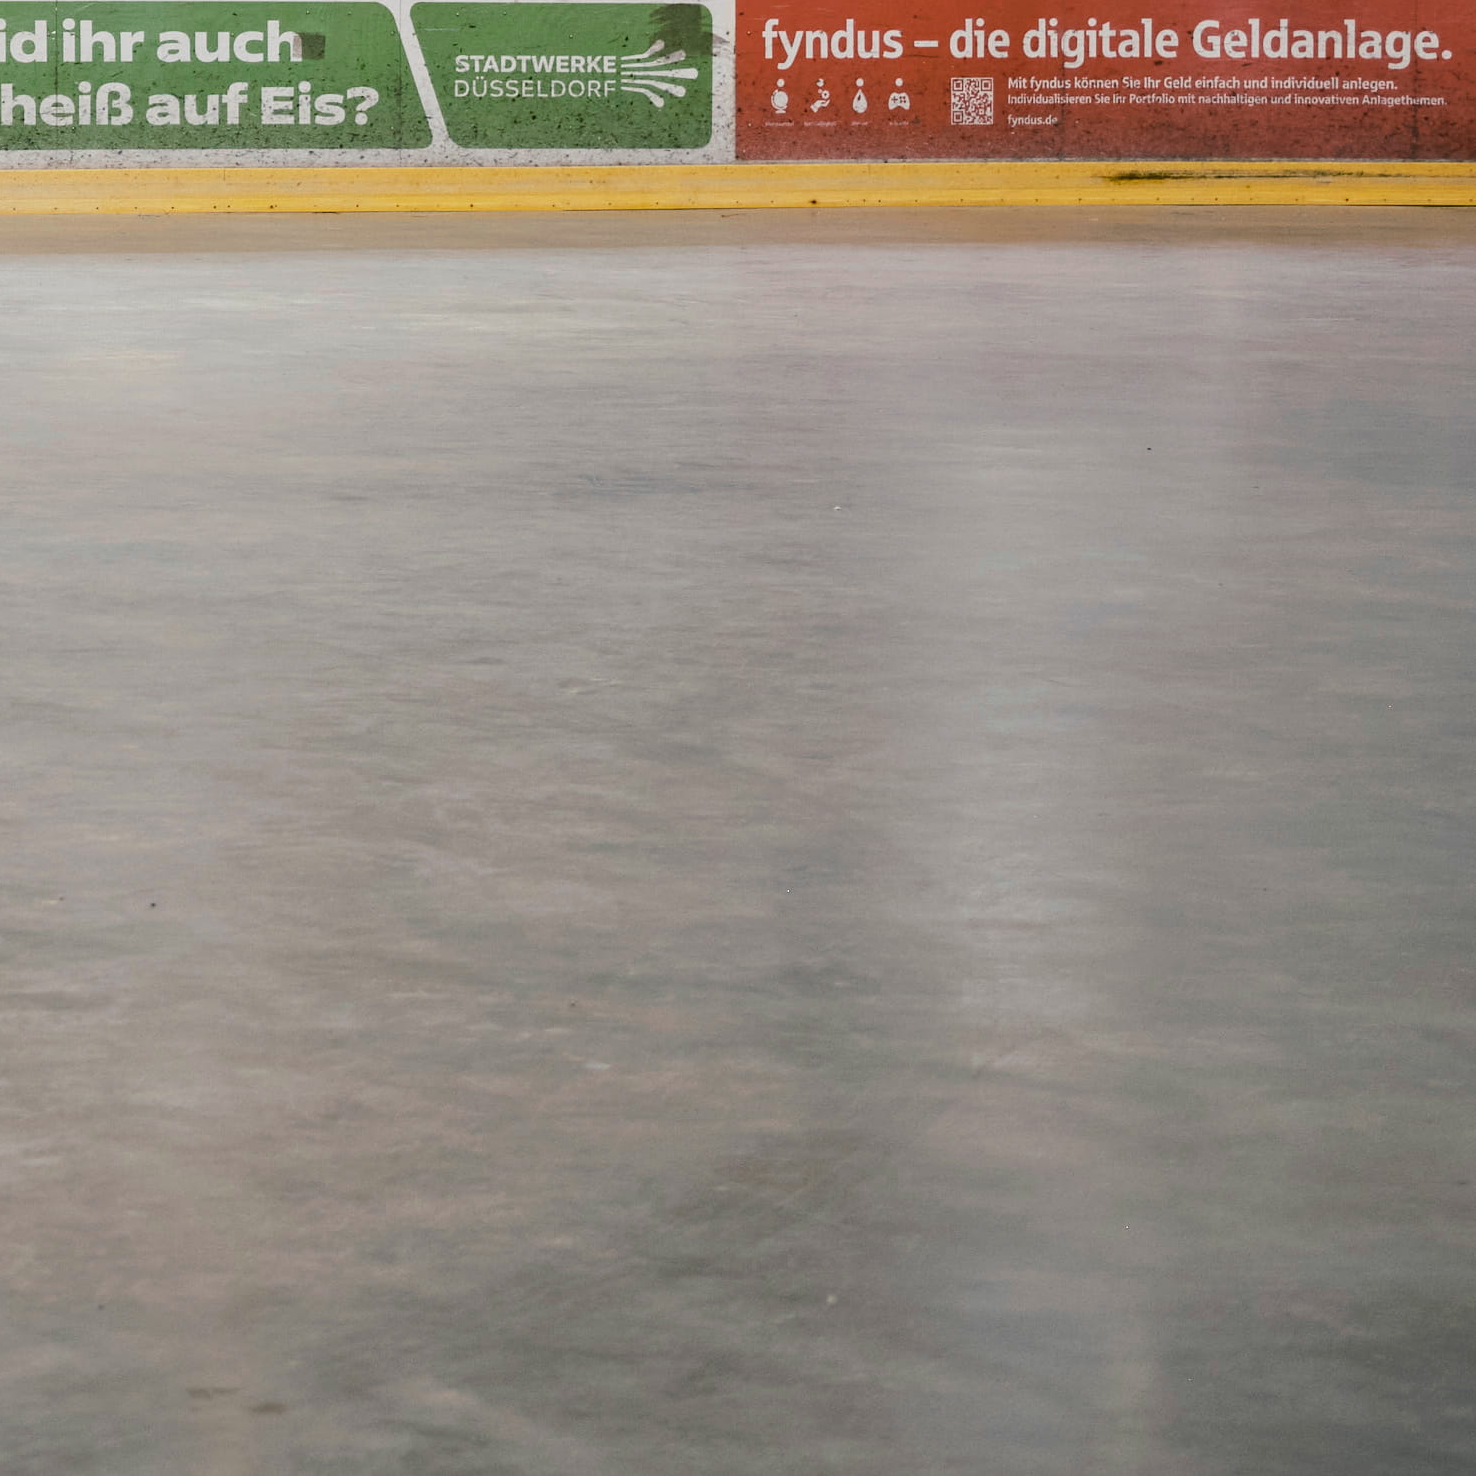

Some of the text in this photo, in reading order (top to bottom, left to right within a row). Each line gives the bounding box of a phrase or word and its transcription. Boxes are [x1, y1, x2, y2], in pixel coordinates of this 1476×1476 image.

[62, 18, 144, 62] ihr
[157, 20, 303, 63] auch
[762, 17, 1452, 70] fyndus die digitale Geldanlage.
[455, 55, 617, 73] STADTWERKE
[455, 76, 617, 97] DÜSSELDORF
[1007, 77, 1398, 92] Mit fyndus können Sie Ihr Geld einfach und individuell anlegen.
[0, 82, 134, 126] heiß
[145, 82, 248, 126] auf
[260, 81, 380, 125] Eis?
[1007, 94, 1092, 105] Individualisieren
[1094, 94, 1110, 104] Sie
[1129, 94, 1175, 104] Portfolio
[1178, 94, 1195, 104] mit
[1198, 93, 1267, 107] nachhaltigen
[1271, 94, 1291, 105] und
[1294, 94, 1359, 105] innovativen
[1007, 114, 1058, 127] fyndus.de
